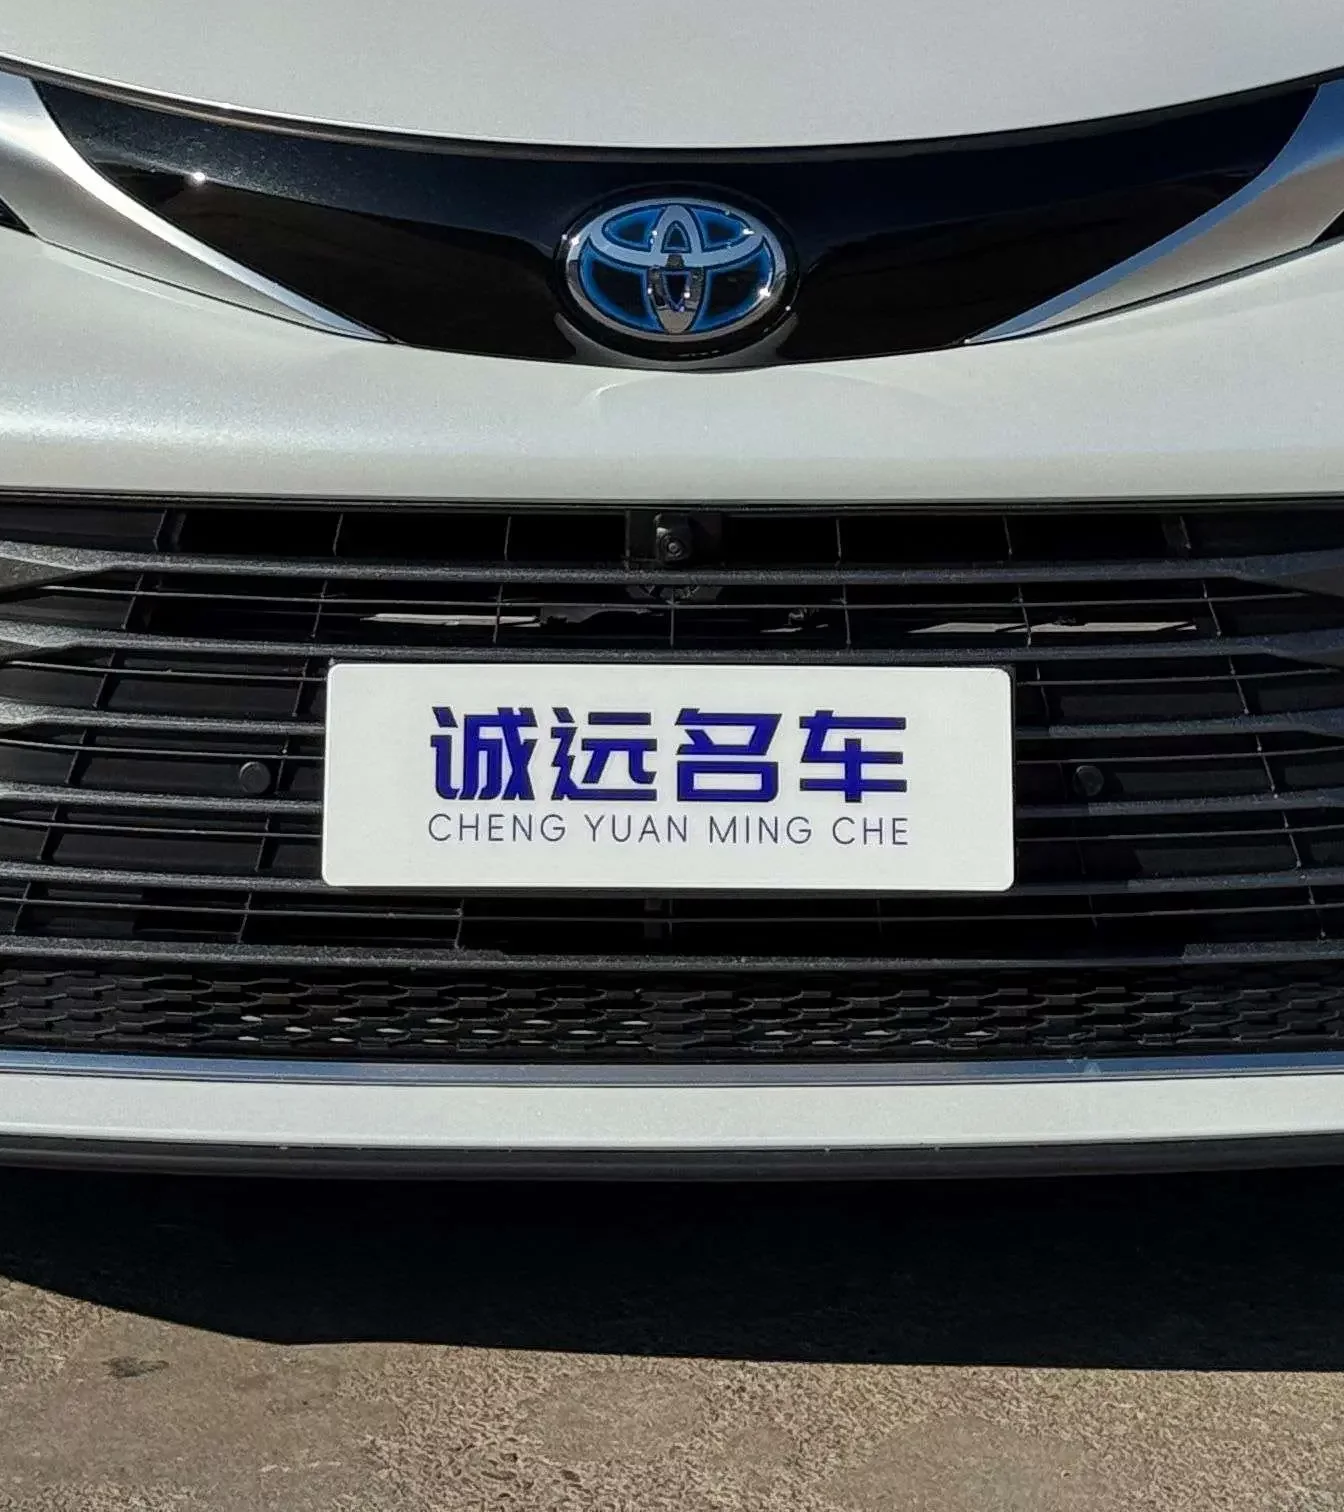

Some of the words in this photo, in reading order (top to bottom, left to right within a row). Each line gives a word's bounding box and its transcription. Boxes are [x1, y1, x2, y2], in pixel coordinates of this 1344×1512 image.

[429, 706, 908, 803] 诚远名车
[428, 813, 566, 842] CHENG
[583, 814, 688, 843] YUAN
[708, 815, 812, 845] MING
[832, 816, 908, 846] CHE
